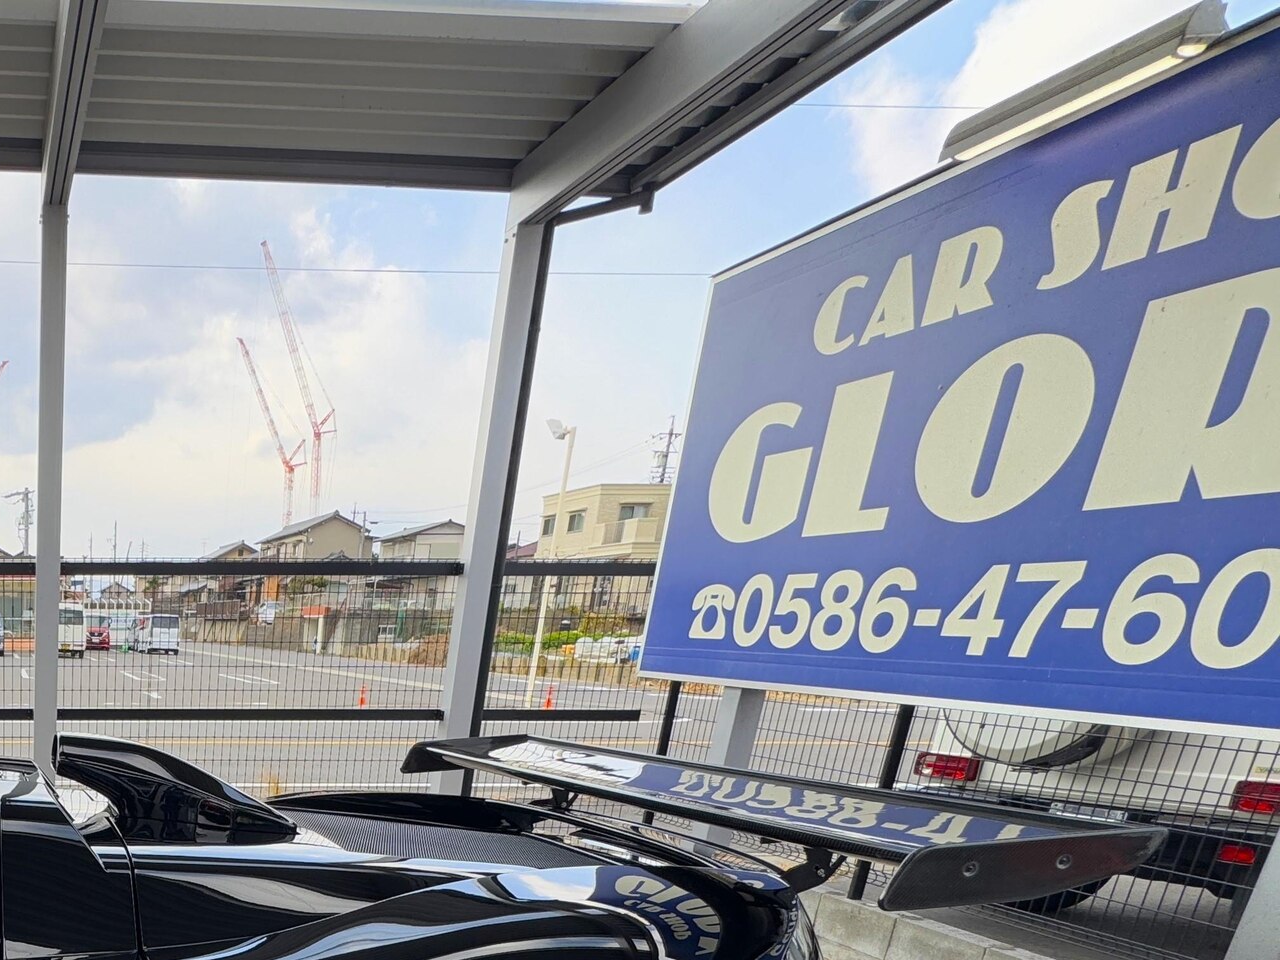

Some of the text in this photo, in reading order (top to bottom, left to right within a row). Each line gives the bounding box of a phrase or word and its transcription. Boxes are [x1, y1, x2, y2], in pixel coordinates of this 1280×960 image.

[814, 225, 1004, 355] CAR
[708, 267, 1280, 543] GLOR
[732, 547, 1280, 669] 0586-47-60
